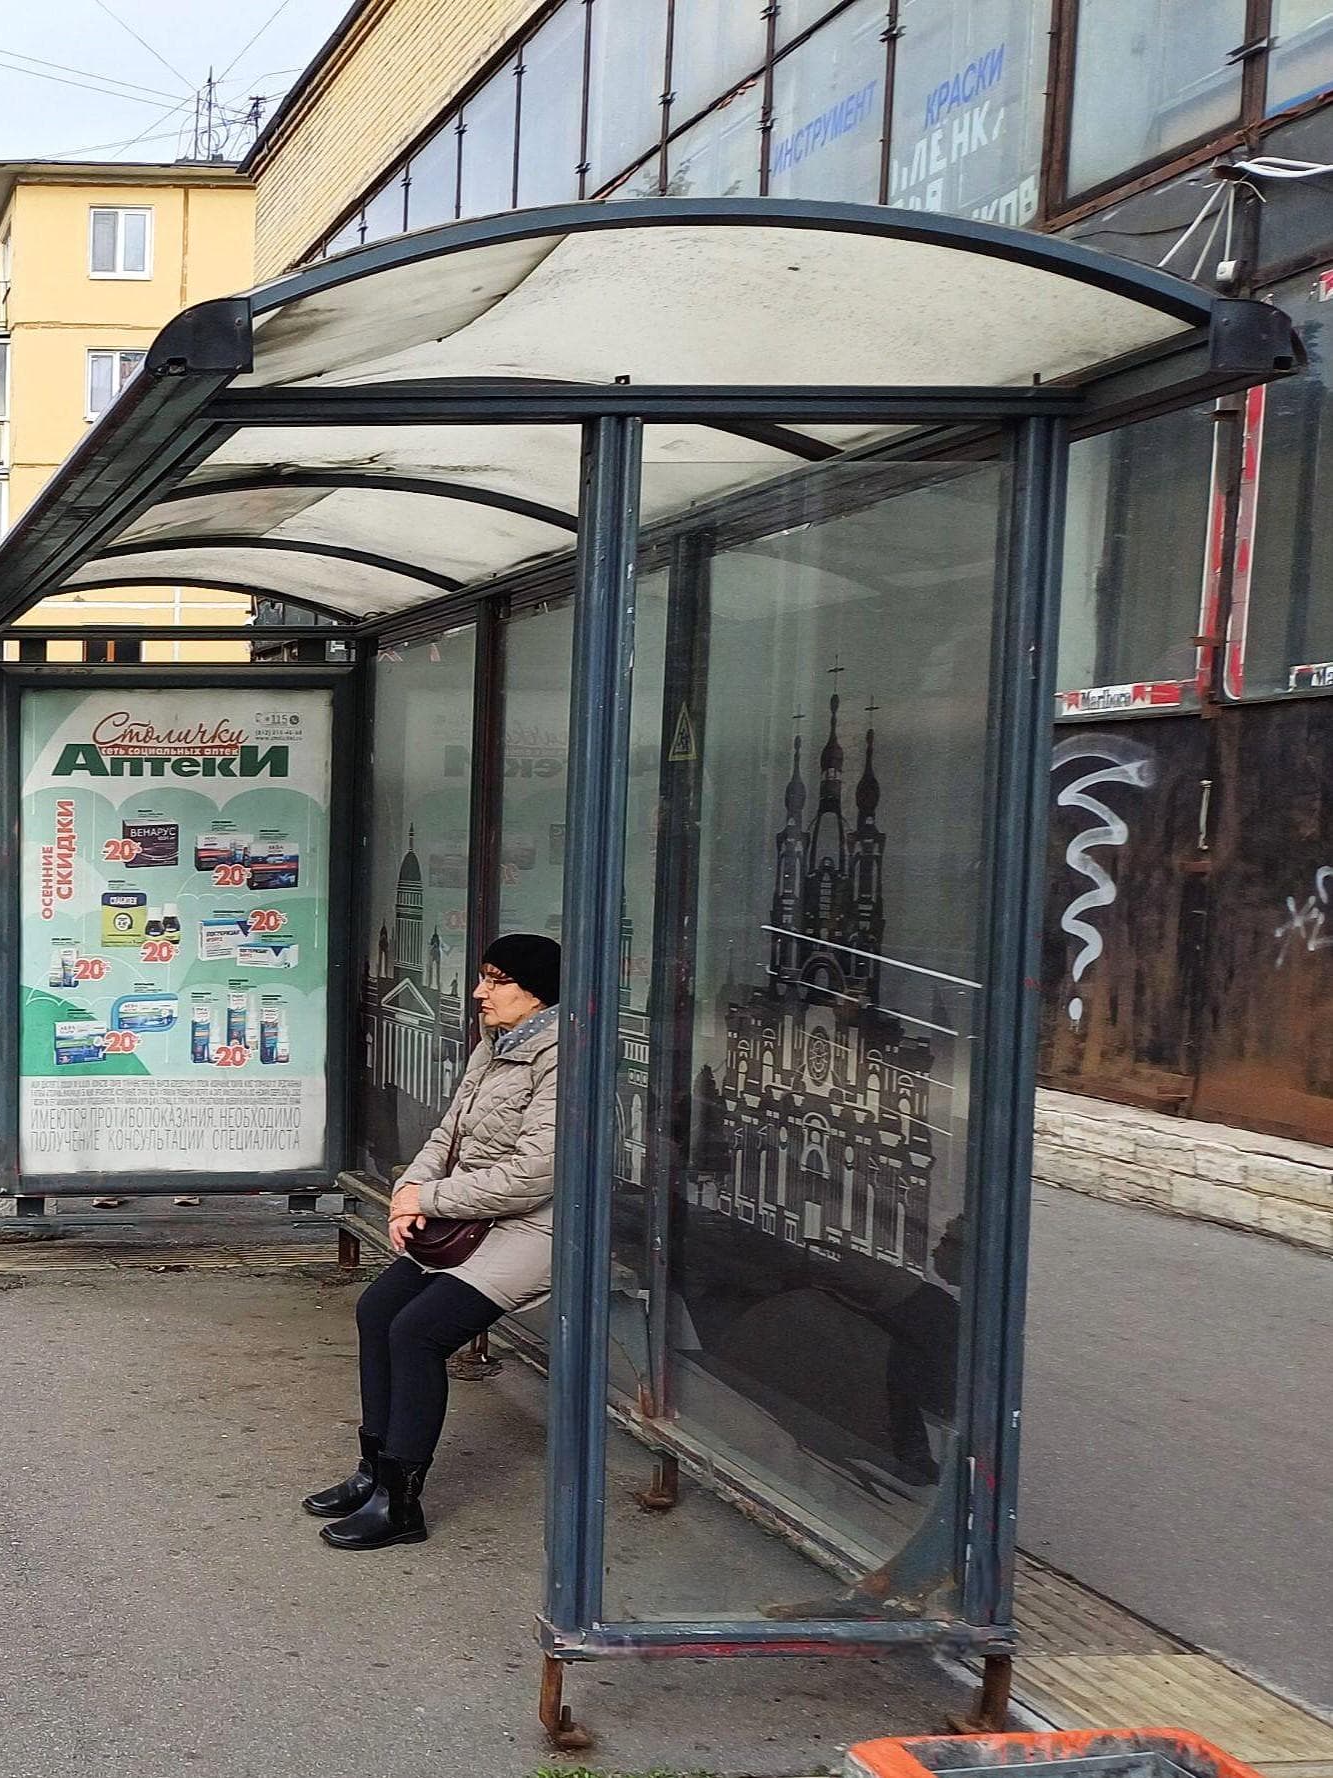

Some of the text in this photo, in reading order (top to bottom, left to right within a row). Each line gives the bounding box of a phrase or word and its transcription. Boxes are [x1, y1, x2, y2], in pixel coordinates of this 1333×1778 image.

[925, 42, 1005, 131] КРАСКИ
[772, 79, 878, 178] ИНСТРУМЕНТ
[92, 711, 250, 746] Столички
[101, 746, 239, 757] сеть социальных аптек
[129, 826, 177, 838] ВЕНАРУС
[56, 800, 77, 900] СКИДКИ
[41, 846, 54, 920] ОСЕННИЕ
[30, 1106, 87, 1129] ИМЕЮТСЯ
[220, 1106, 301, 1129] НЕОБХОДИМО
[30, 1129, 301, 1152] ПОЛУЧЕНИЕ КОНСУЛЬТАЦИИ СПЕЦИАЛИСТА
